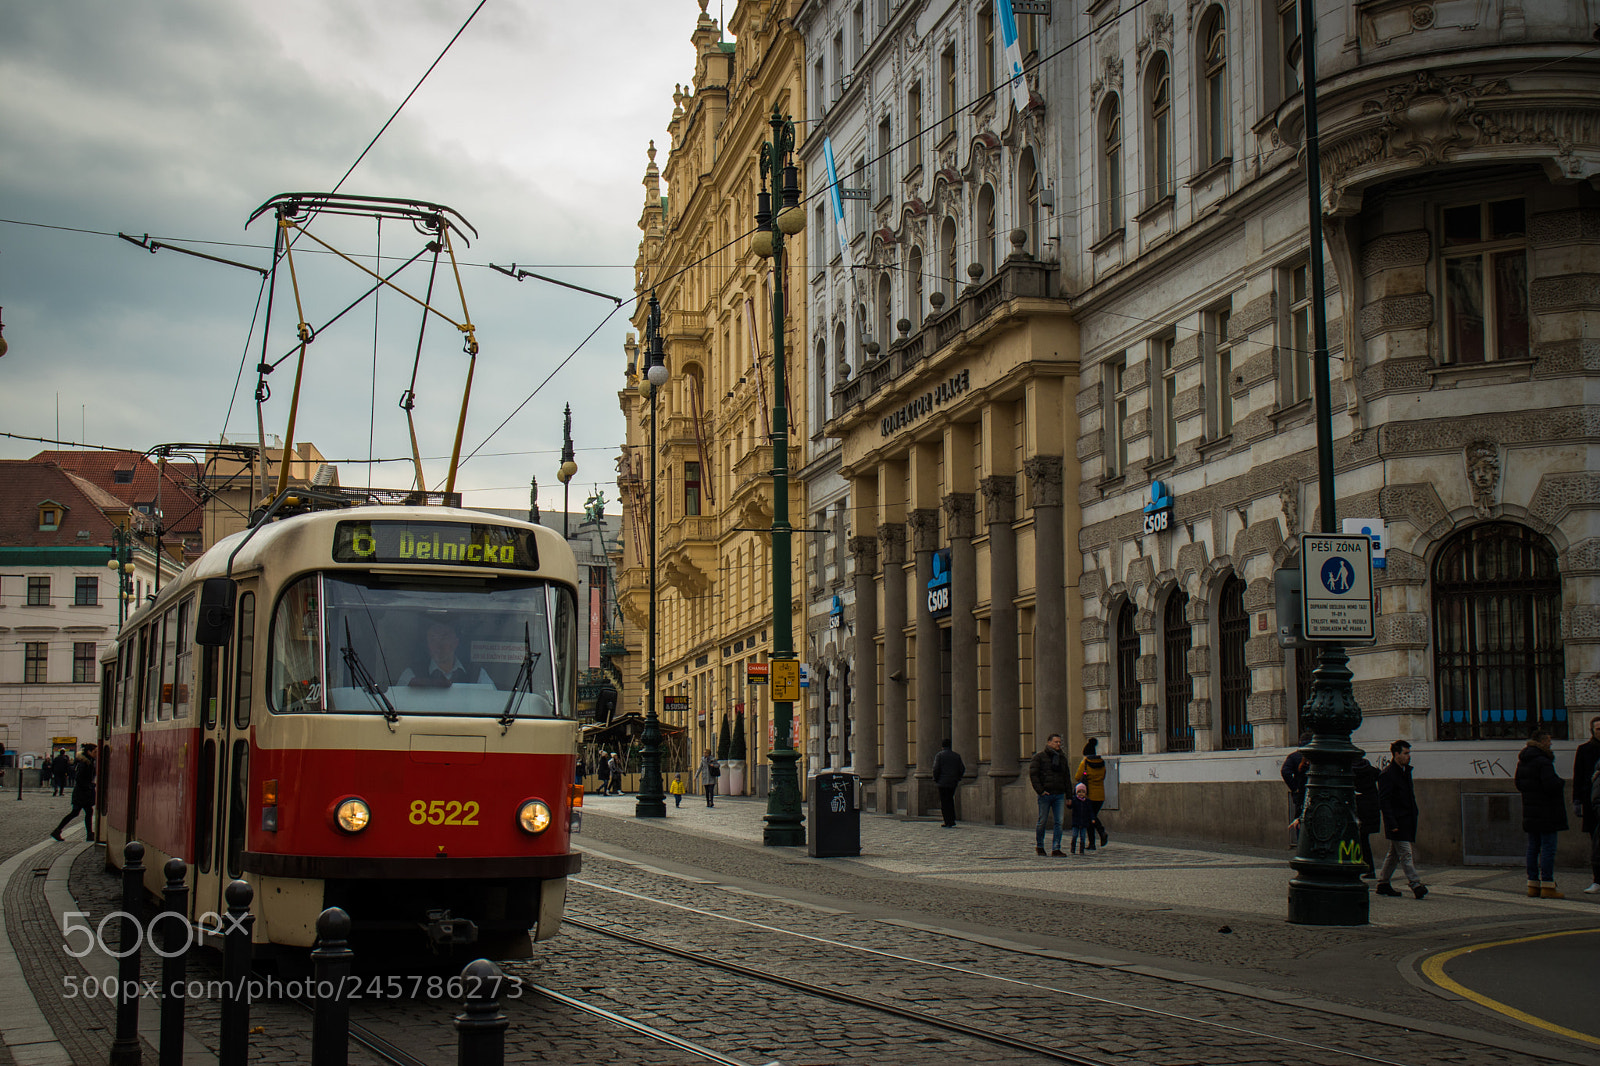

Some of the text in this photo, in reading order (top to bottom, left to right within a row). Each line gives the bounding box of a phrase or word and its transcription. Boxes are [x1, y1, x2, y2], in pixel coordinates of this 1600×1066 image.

[881, 369, 970, 437] KONEKTOR PLACE
[1143, 511, 1168, 534] ČSOB
[352, 525, 514, 563] 6 Dělnická
[1311, 540, 1333, 552] PĚŠÍ
[1336, 541, 1362, 552] ZÓNA
[928, 588, 949, 612] ČSOB
[409, 800, 480, 825] 8522
